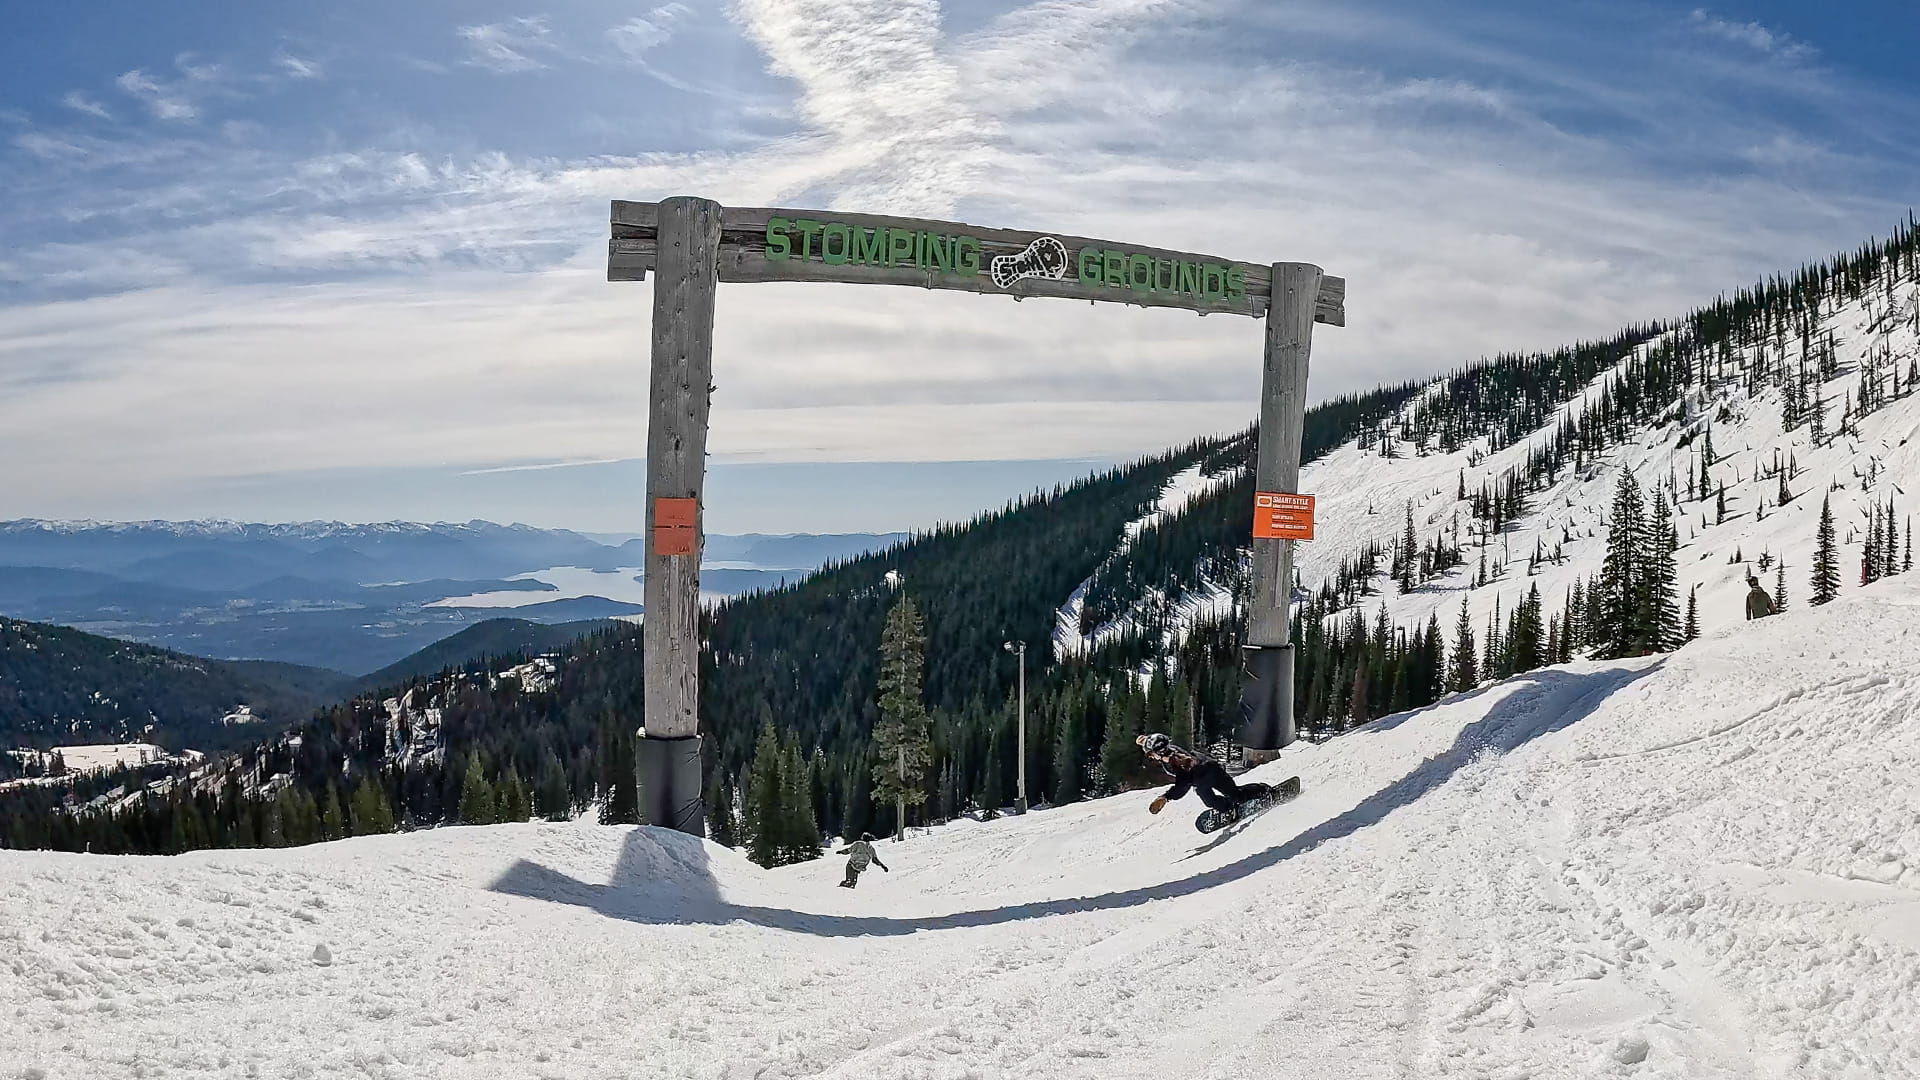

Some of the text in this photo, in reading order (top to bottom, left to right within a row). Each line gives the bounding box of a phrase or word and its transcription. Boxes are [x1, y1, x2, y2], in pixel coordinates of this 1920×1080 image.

[765, 216, 1246, 301] STOMPING GROUNDS
[1273, 496, 1292, 504] SMART
